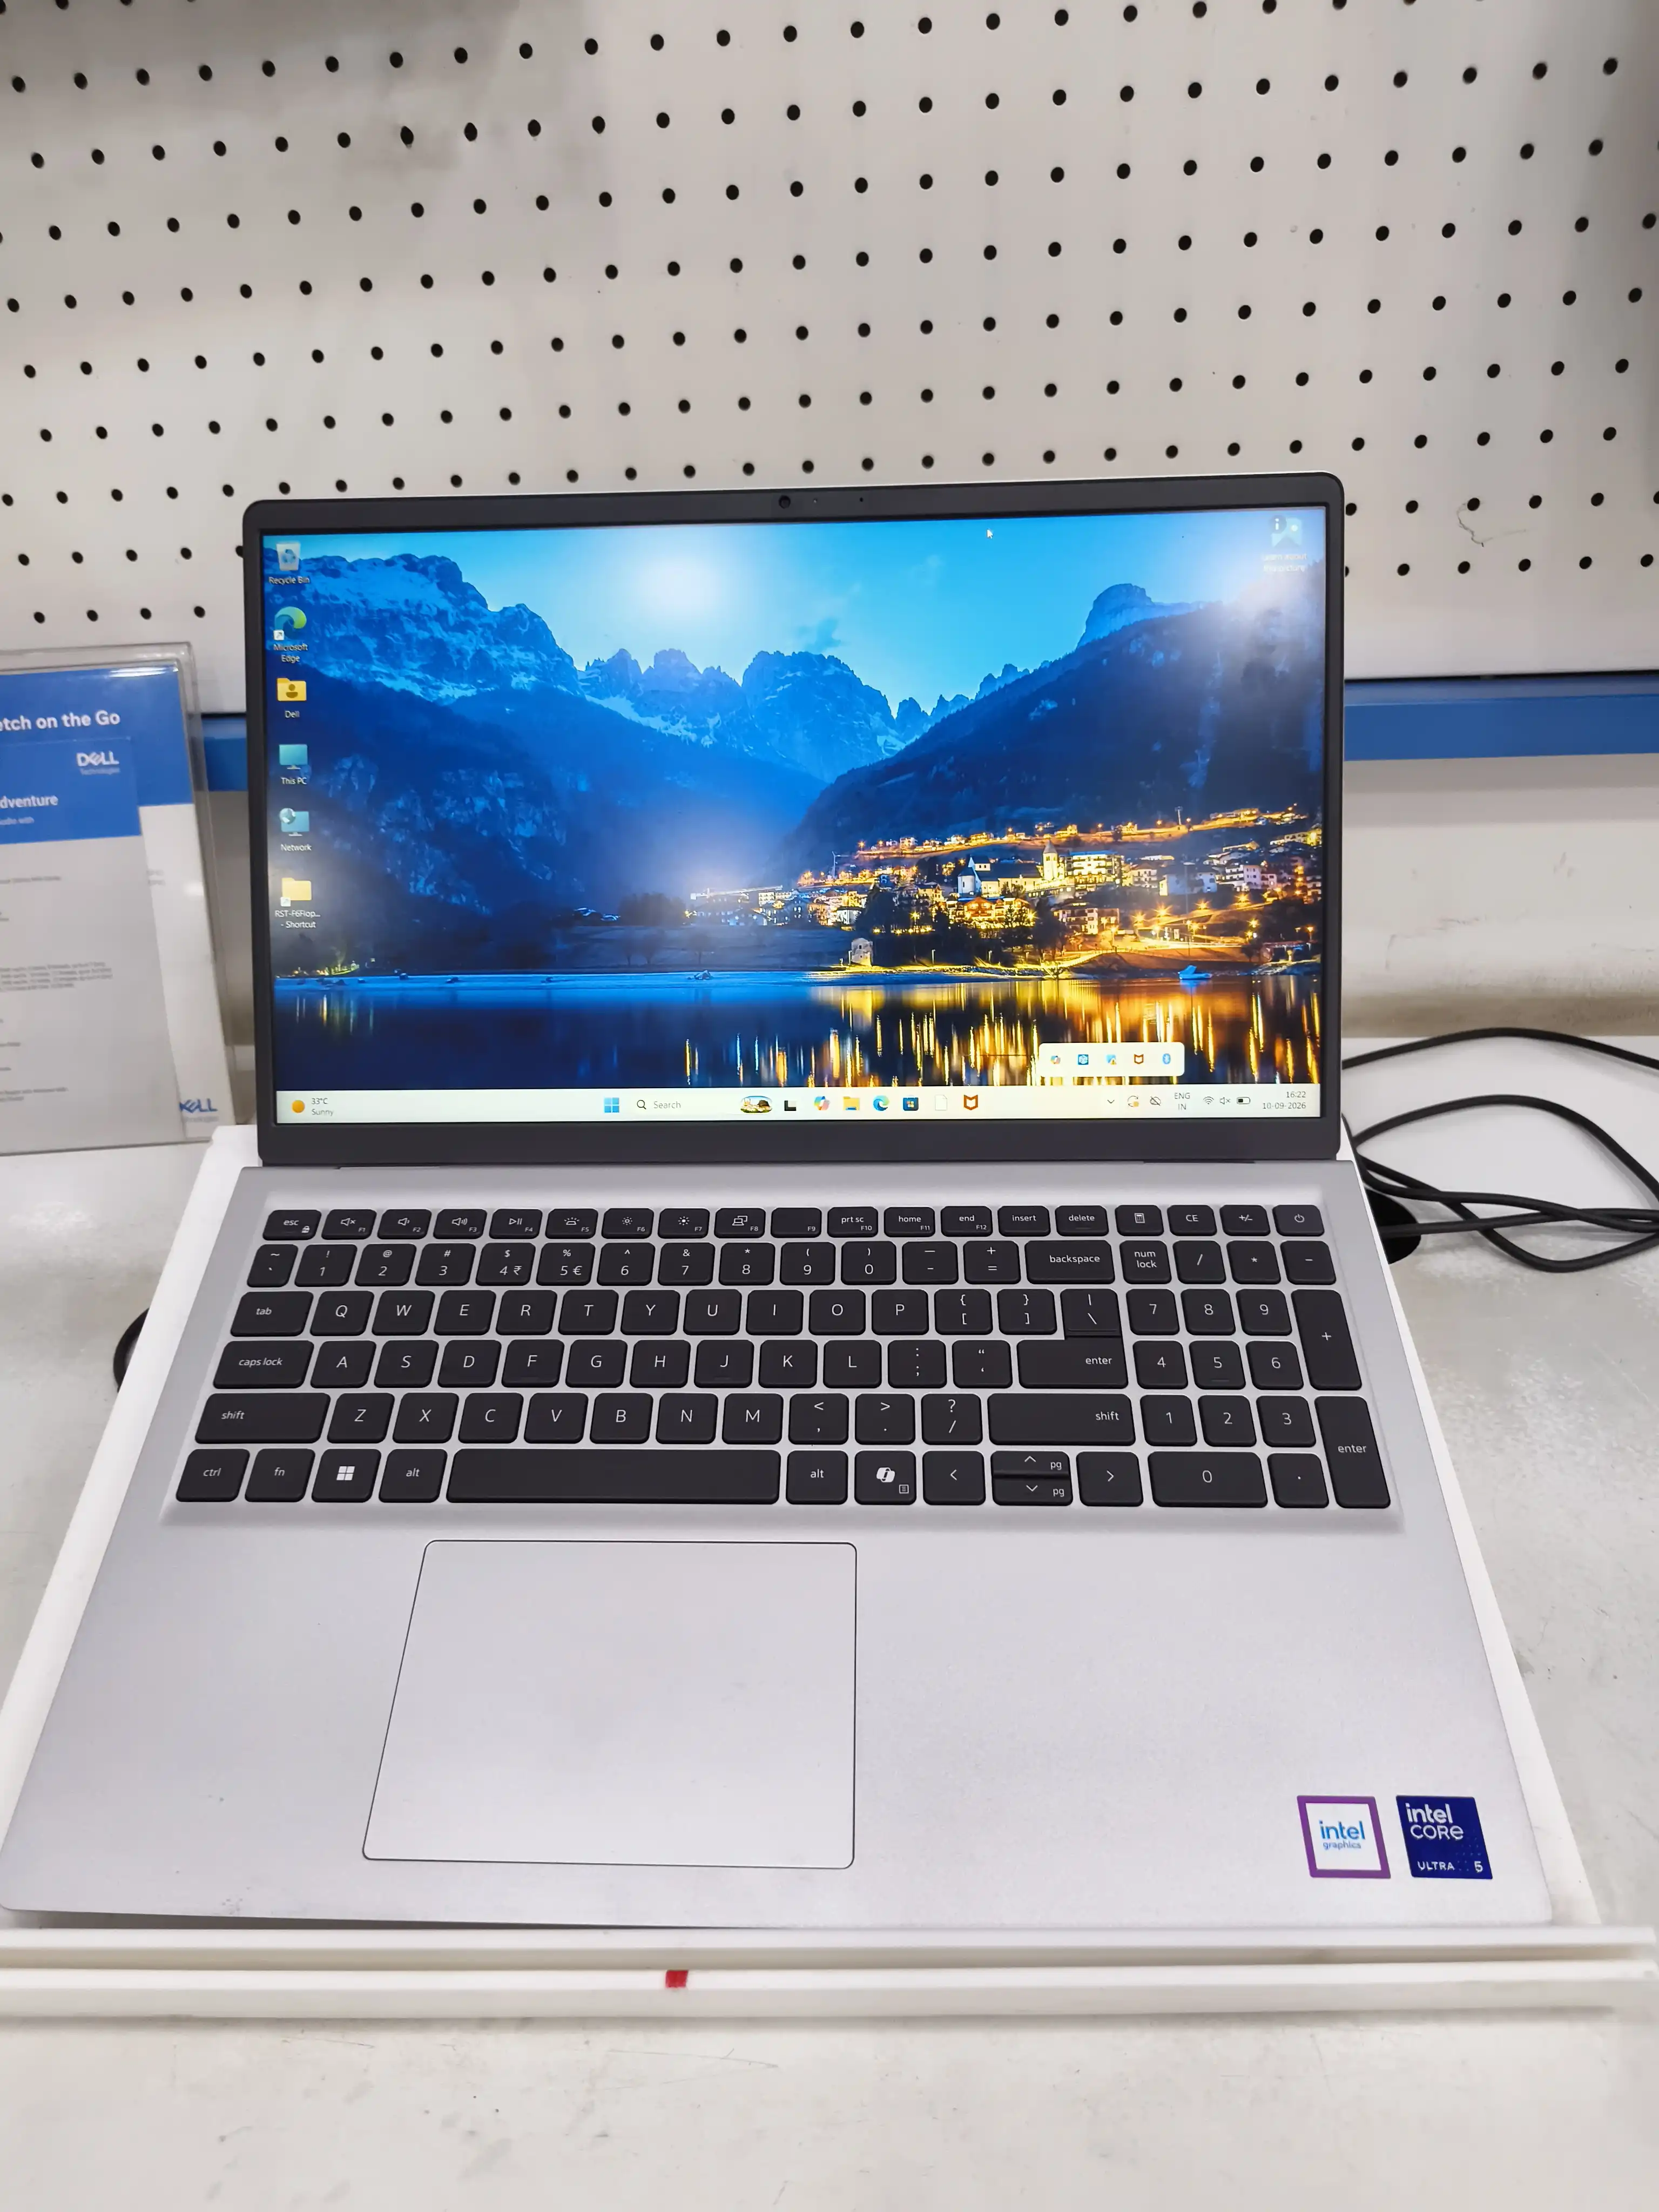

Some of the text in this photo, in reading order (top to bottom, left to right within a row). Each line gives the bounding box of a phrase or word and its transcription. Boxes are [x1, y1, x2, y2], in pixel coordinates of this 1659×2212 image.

[269, 576, 296, 585] Recycle
[273, 643, 308, 651] Microsoft
[281, 655, 300, 663] Edge
[36, 717, 58, 729] on
[61, 711, 91, 727] the
[95, 710, 120, 725] Go
[76, 751, 119, 767] DELL
[281, 777, 307, 785] This PC
[281, 844, 312, 852] Network
[653, 1100, 682, 1110] Search
[1262, 1102, 1306, 1110] 10-09-2026
[311, 1108, 334, 1117] Sunny
[841, 1216, 854, 1224] prt
[382, 1250, 393, 1258] @
[504, 1250, 510, 1258] $
[683, 1249, 690, 1257] &
[806, 1248, 810, 1257] (
[867, 1247, 871, 1256] )
[987, 1246, 996, 1255] +
[1049, 1255, 1100, 1264] backspace
[1136, 1259, 1157, 1268] lock
[1197, 1253, 1203, 1266] /
[320, 1266, 326, 1276] 1
[378, 1266, 387, 1276] 2
[439, 1265, 448, 1276] 3
[500, 1265, 522, 1276] 4 ₹
[560, 1265, 583, 1276] 5 €
[621, 1265, 629, 1276] 6
[682, 1265, 689, 1275] 7
[742, 1264, 751, 1274] 8
[803, 1264, 812, 1275] 9
[865, 1264, 874, 1274] 0
[960, 1294, 966, 1306] {
[1023, 1294, 1029, 1306] }
[256, 1307, 272, 1315] tab
[335, 1305, 348, 1318] Q
[396, 1305, 412, 1316] W
[460, 1304, 470, 1316] E
[521, 1304, 531, 1316] R
[584, 1304, 594, 1316] T
[646, 1304, 656, 1316] Y
[707, 1304, 718, 1317] U
[773, 1304, 776, 1316] I
[832, 1304, 844, 1316] O
[896, 1304, 905, 1316] P
[1149, 1304, 1157, 1314] 7
[1204, 1304, 1213, 1316] 8
[1259, 1304, 1269, 1315] 9
[962, 1313, 967, 1325] [
[1024, 1312, 1030, 1325] ]
[1087, 1313, 1097, 1325] \
[1321, 1332, 1332, 1341] +
[239, 1357, 283, 1368] caps lock
[336, 1356, 347, 1368] A
[401, 1355, 412, 1368] S
[463, 1355, 475, 1368] D
[527, 1354, 538, 1367] F
[591, 1355, 602, 1368] G
[655, 1355, 666, 1367] H
[720, 1355, 729, 1367] J
[783, 1355, 793, 1367] K
[848, 1355, 857, 1368] L
[1085, 1357, 1112, 1365] enter
[1157, 1357, 1166, 1368] 4
[1213, 1357, 1222, 1368] 5
[1271, 1357, 1281, 1369] 6
[814, 1401, 824, 1411] <
[880, 1402, 891, 1411] >
[948, 1399, 956, 1413] ?
[221, 1410, 245, 1420] shift
[354, 1409, 367, 1422] Z
[419, 1409, 431, 1422] X
[485, 1409, 496, 1422] C
[551, 1409, 562, 1422] V
[616, 1410, 626, 1422] B
[680, 1410, 693, 1422] N
[746, 1409, 760, 1422] M
[1095, 1411, 1120, 1420] shift
[1166, 1412, 1172, 1424] 1
[1223, 1412, 1233, 1425] 2
[1282, 1412, 1292, 1425] 3
[948, 1420, 956, 1433] /
[1338, 1445, 1366, 1453] enter
[203, 1467, 221, 1476] ctrl
[274, 1467, 285, 1476] fn
[1050, 1461, 1062, 1471] pg
[406, 1468, 420, 1477] alt
[810, 1468, 824, 1478] alt
[1202, 1470, 1212, 1483] 0
[1053, 1488, 1064, 1498] pg
[1405, 1803, 1453, 1823] intel
[1318, 1820, 1366, 1840] intel
[1323, 1840, 1362, 1850] graphics
[1417, 1860, 1483, 1873] ULTRA 5
